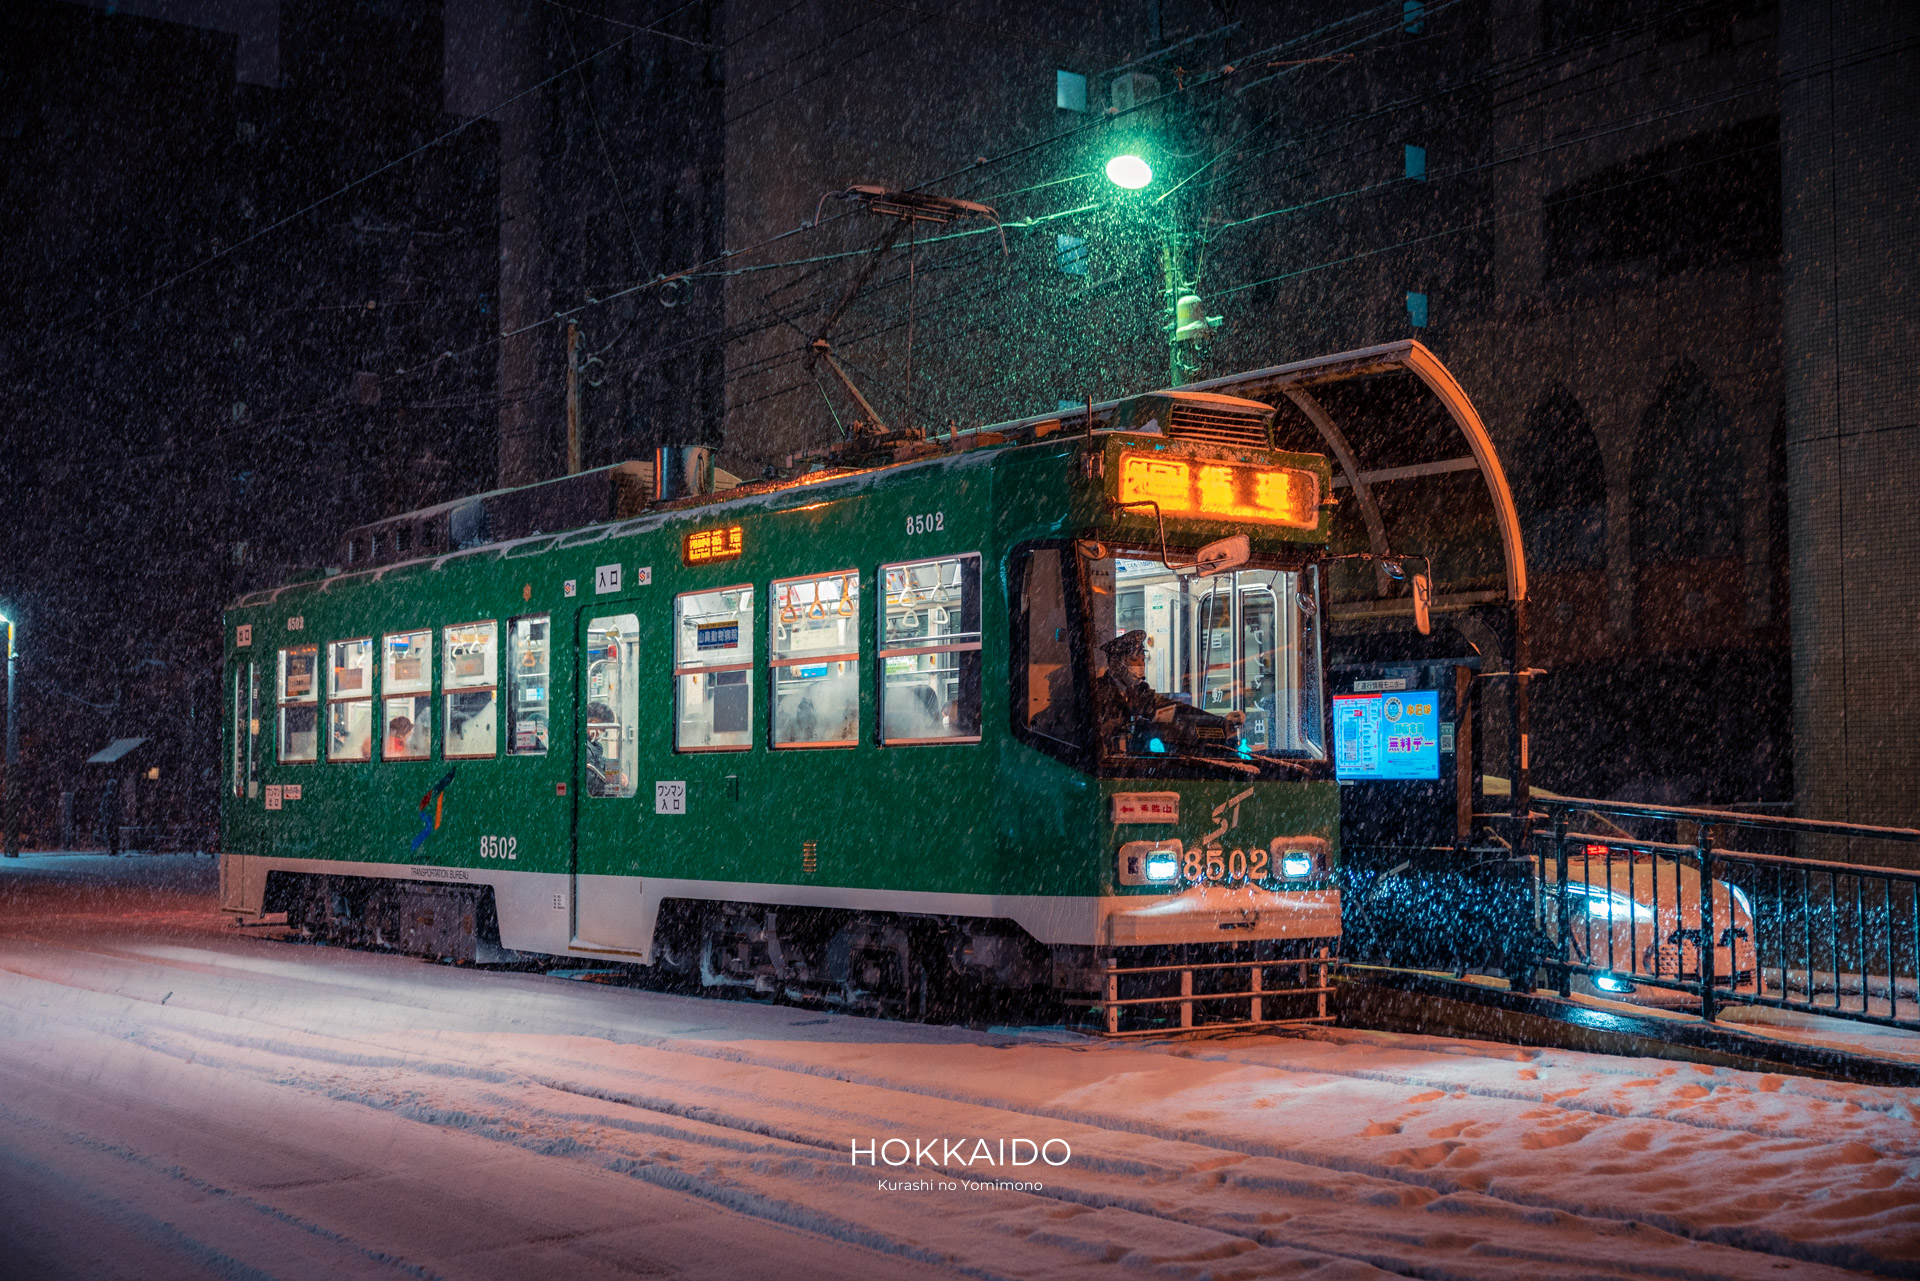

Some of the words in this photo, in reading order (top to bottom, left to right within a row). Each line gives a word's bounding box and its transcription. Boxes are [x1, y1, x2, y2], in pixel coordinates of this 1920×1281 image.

[906, 511, 944, 535] 8502
[599, 570, 618, 588] 入口
[287, 616, 304, 631] 8502
[1388, 736, 1435, 752] 無料デー
[657, 785, 684, 797] ワンマン
[661, 799, 680, 810] 入口
[480, 834, 517, 860] 8502
[1183, 849, 1268, 881] 8502
[410, 867, 448, 878] TRANSPORTATION
[449, 870, 469, 880] BUREAU
